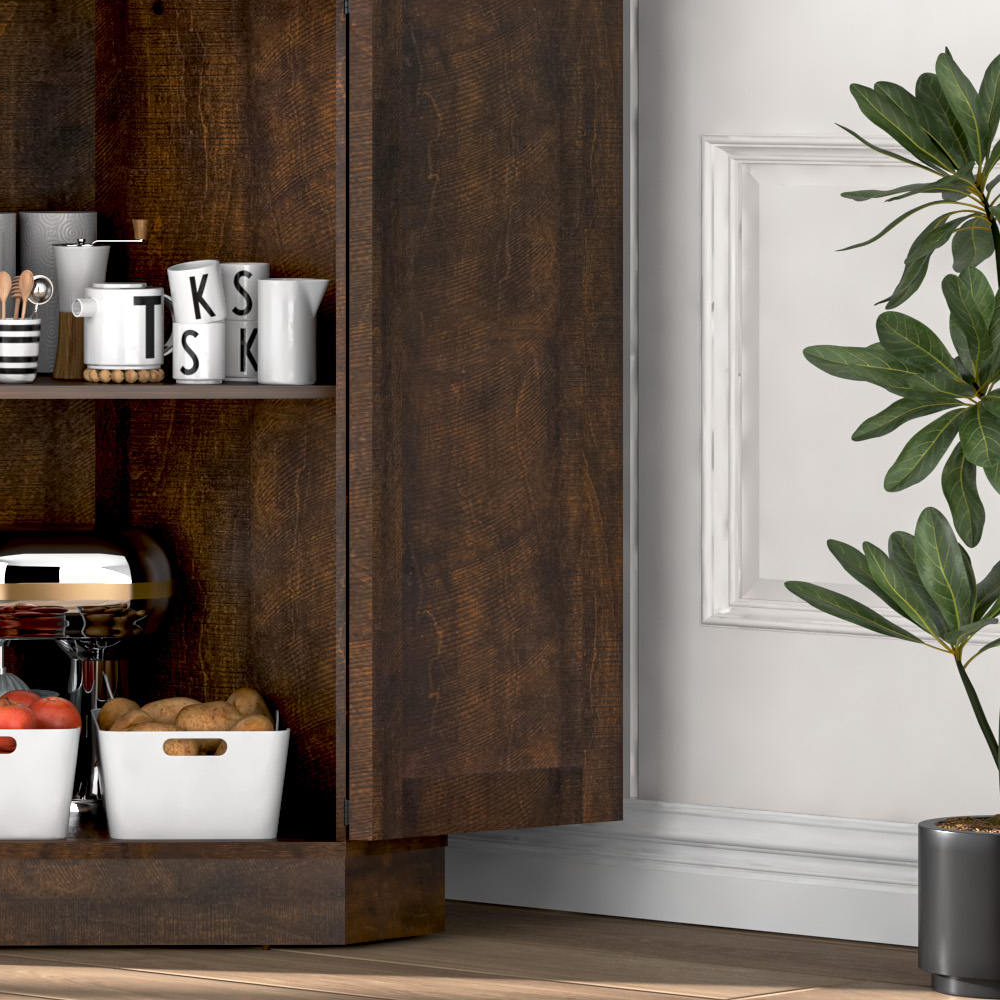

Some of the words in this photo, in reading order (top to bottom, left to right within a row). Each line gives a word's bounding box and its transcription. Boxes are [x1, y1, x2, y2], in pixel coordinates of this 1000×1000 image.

[189, 274, 216, 319] K
[232, 270, 252, 316] S
[134, 296, 161, 359] T
[240, 328, 258, 372] K
[180, 330, 199, 375] S
